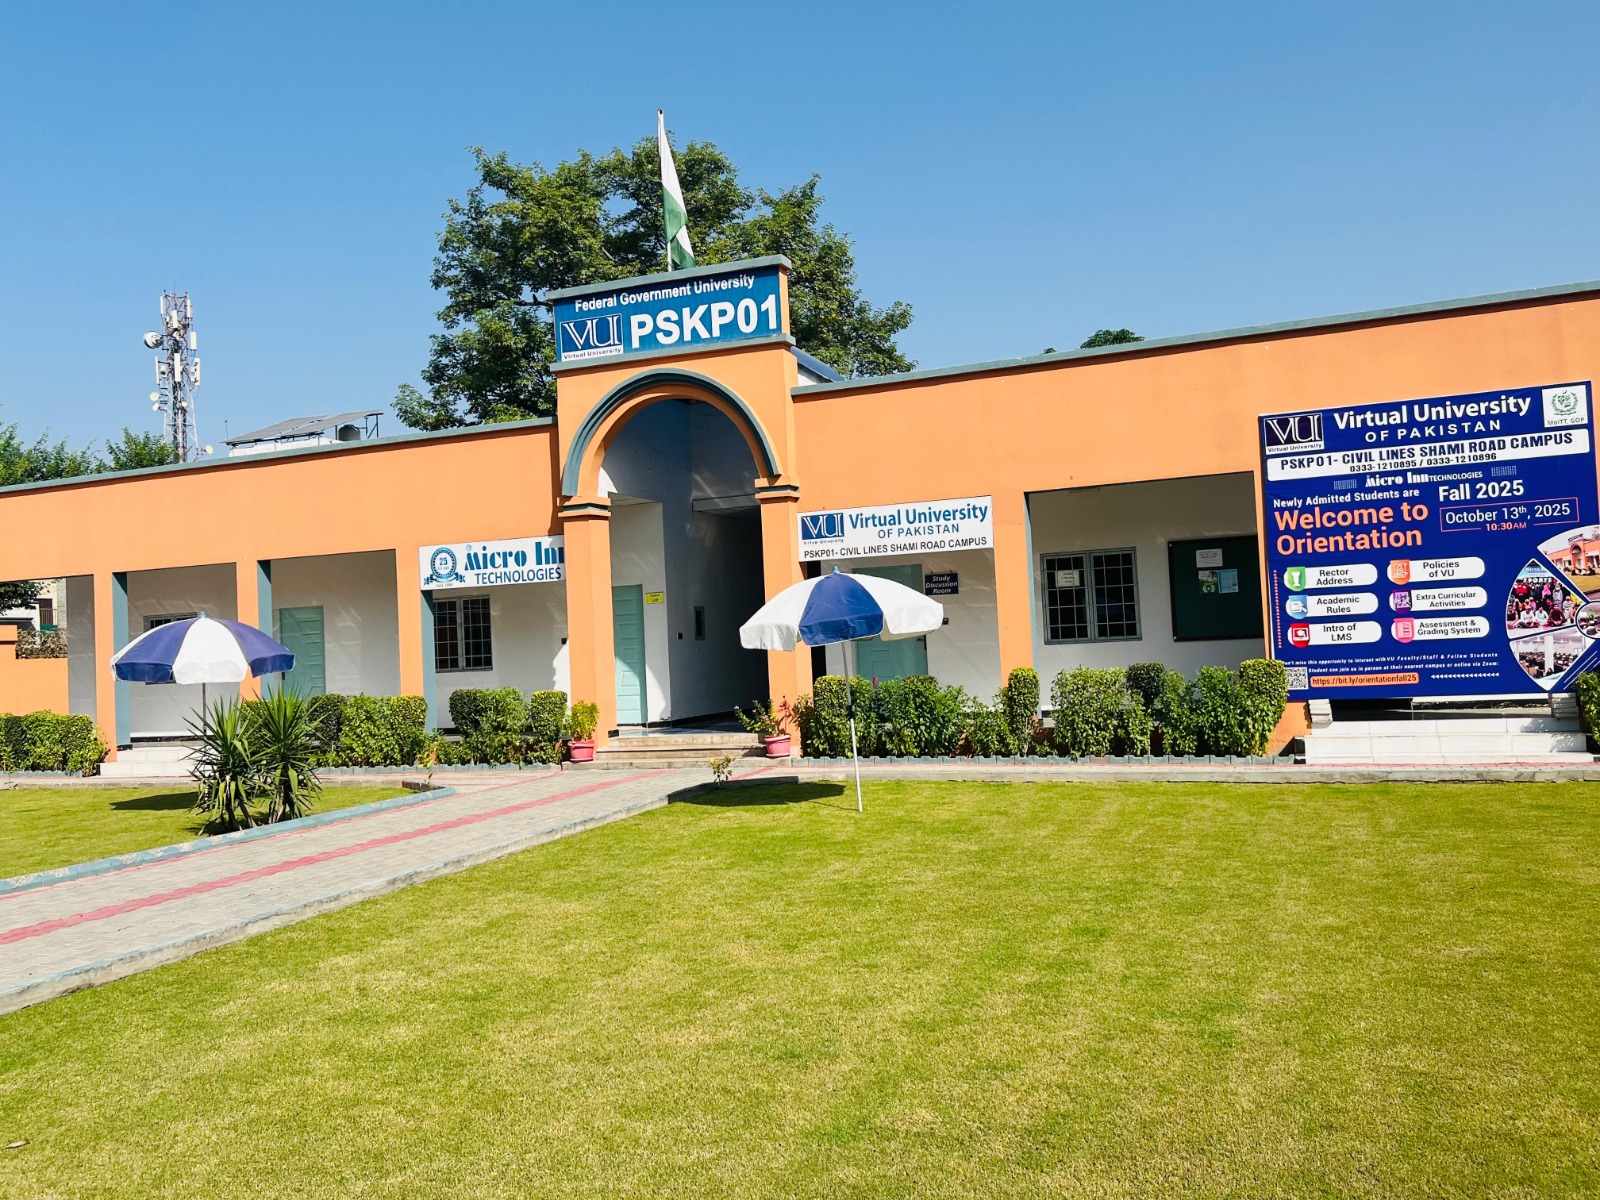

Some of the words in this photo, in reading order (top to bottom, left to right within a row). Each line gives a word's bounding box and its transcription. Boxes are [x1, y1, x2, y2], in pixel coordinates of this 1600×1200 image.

[575, 293, 617, 313] Federal
[620, 284, 691, 306] Government
[694, 274, 755, 295] University
[630, 294, 778, 349] PSKP01
[562, 315, 621, 350] VU
[564, 352, 586, 360] Virtual
[587, 348, 622, 358] University
[1333, 405, 1408, 430] Virtual
[1414, 394, 1531, 422] University
[1267, 414, 1322, 444] VU
[1365, 430, 1389, 443] OF
[1397, 420, 1500, 440] PAKISTAN
[1280, 456, 1338, 470] PSKP01-
[1342, 452, 1375, 464] CIVIL
[1379, 447, 1415, 461] LINES
[1419, 443, 1464, 457] SHAMI
[1468, 438, 1506, 453] ROAD
[1510, 432, 1573, 448] CAMPUS
[1350, 460, 1417, 473] 0333-1210895
[1426, 453, 1497, 466] 0333-1210896
[1365, 474, 1403, 488] Micro
[1407, 472, 1429, 484] Inn
[1428, 470, 1483, 482] TECHNOLOGIES
[1273, 497, 1302, 508] Newly
[1305, 493, 1350, 506] Admitted
[1354, 490, 1400, 501] Students
[1402, 489, 1420, 498] are
[1438, 482, 1470, 502] Fall
[1475, 480, 1524, 499] 2025
[849, 509, 902, 530] Virtual
[905, 503, 988, 524] University
[1274, 506, 1394, 531] Welcome
[1400, 502, 1428, 522] to
[1445, 509, 1498, 524] October
[1502, 506, 1531, 520] 13th,
[1534, 502, 1570, 518] 2025
[802, 513, 844, 538] VU
[878, 528, 894, 539] OF
[898, 523, 960, 538] PAKISTAN
[804, 548, 838, 559] PSKP01-
[840, 546, 862, 556] CIVIL
[863, 544, 888, 555] LINES
[890, 542, 918, 553] SHAMI
[920, 540, 946, 550] ROAD
[948, 536, 987, 548] CAMPUS
[1276, 526, 1422, 556] Orientation
[439, 557, 448, 566] 25
[464, 544, 528, 571] Micro
[1423, 560, 1460, 569] Policies
[475, 566, 562, 585] TECHNOLOGIES
[1316, 577, 1354, 586] Address
[1429, 570, 1438, 578] of
[1316, 596, 1360, 604] Academic
[1429, 600, 1466, 608] Activities
[1438, 592, 1476, 600] Curricular
[1326, 606, 1351, 614] Rules
[1323, 624, 1344, 632] Intro
[1347, 623, 1356, 631] of
[1418, 627, 1448, 636] Grading
[1450, 627, 1480, 635] System
[1420, 620, 1468, 628] Assessment
[1331, 633, 1352, 642] LMS
